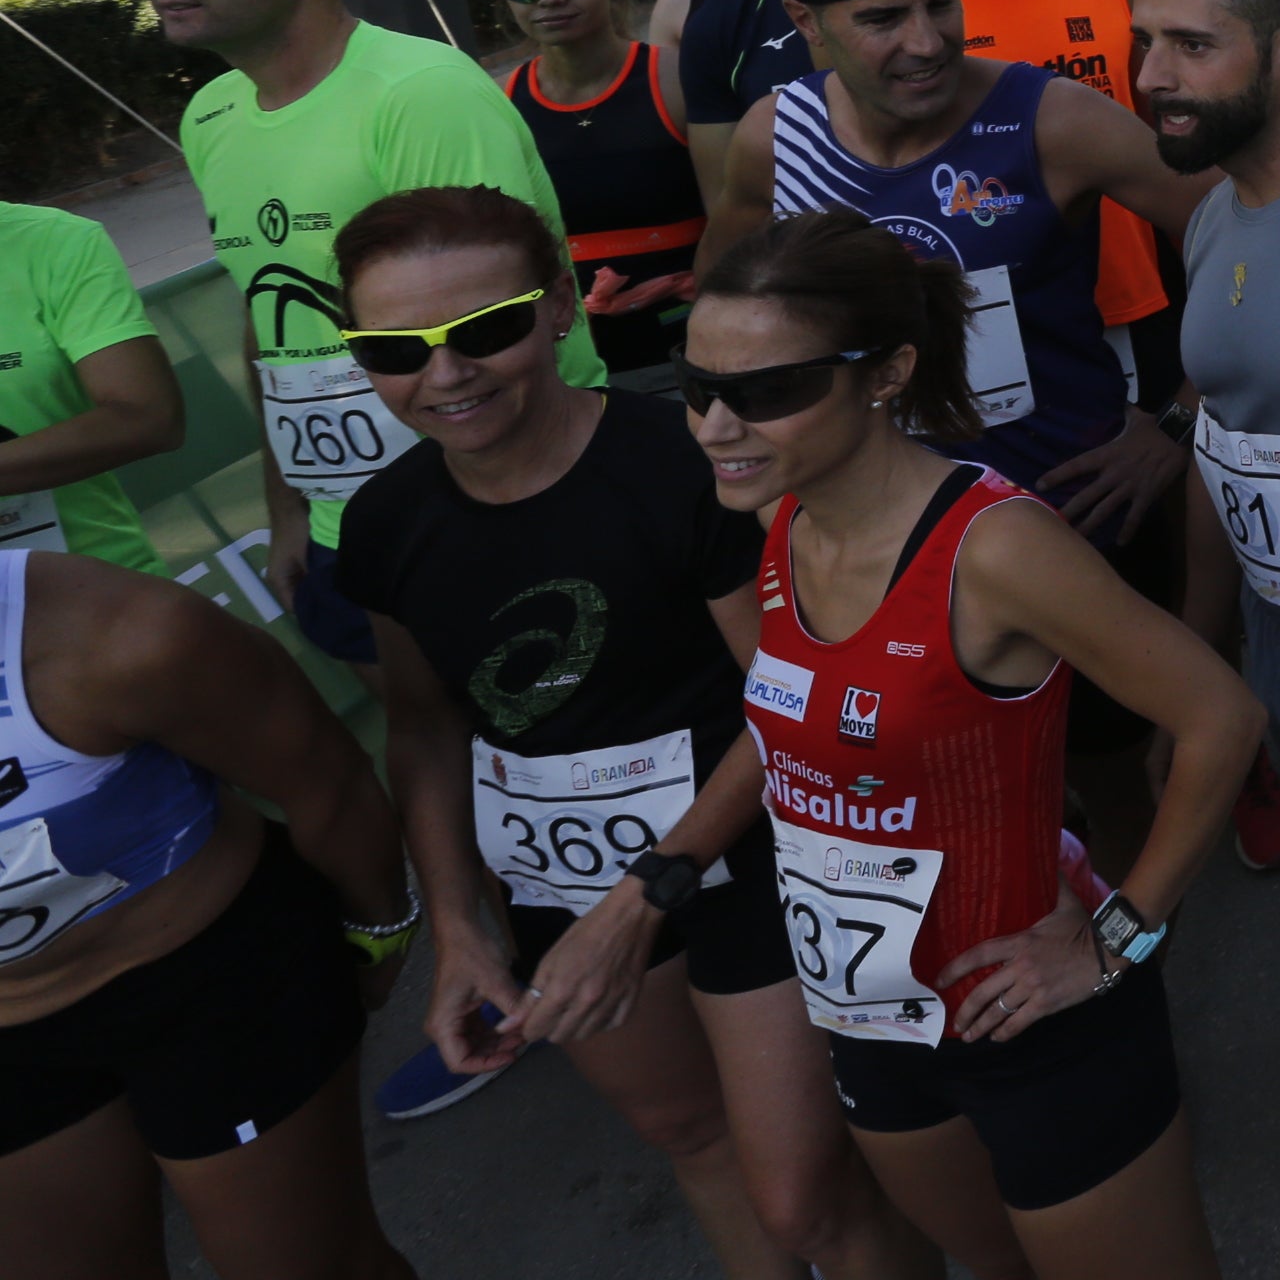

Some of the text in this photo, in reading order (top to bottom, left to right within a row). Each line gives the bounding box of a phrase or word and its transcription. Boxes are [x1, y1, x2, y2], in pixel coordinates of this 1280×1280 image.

[1070, 31, 1095, 42] RUN
[986, 122, 1022, 134] Cervi
[291, 220, 334, 232] MUJER
[277, 409, 385, 467] 260
[1221, 480, 1276, 556] 81
[839, 716, 876, 737] MOVE
[590, 756, 656, 784] GRANADA
[773, 750, 834, 789] Clínicas
[765, 768, 918, 834] lisalud
[501, 812, 660, 877] 369
[780, 892, 887, 997] 37
